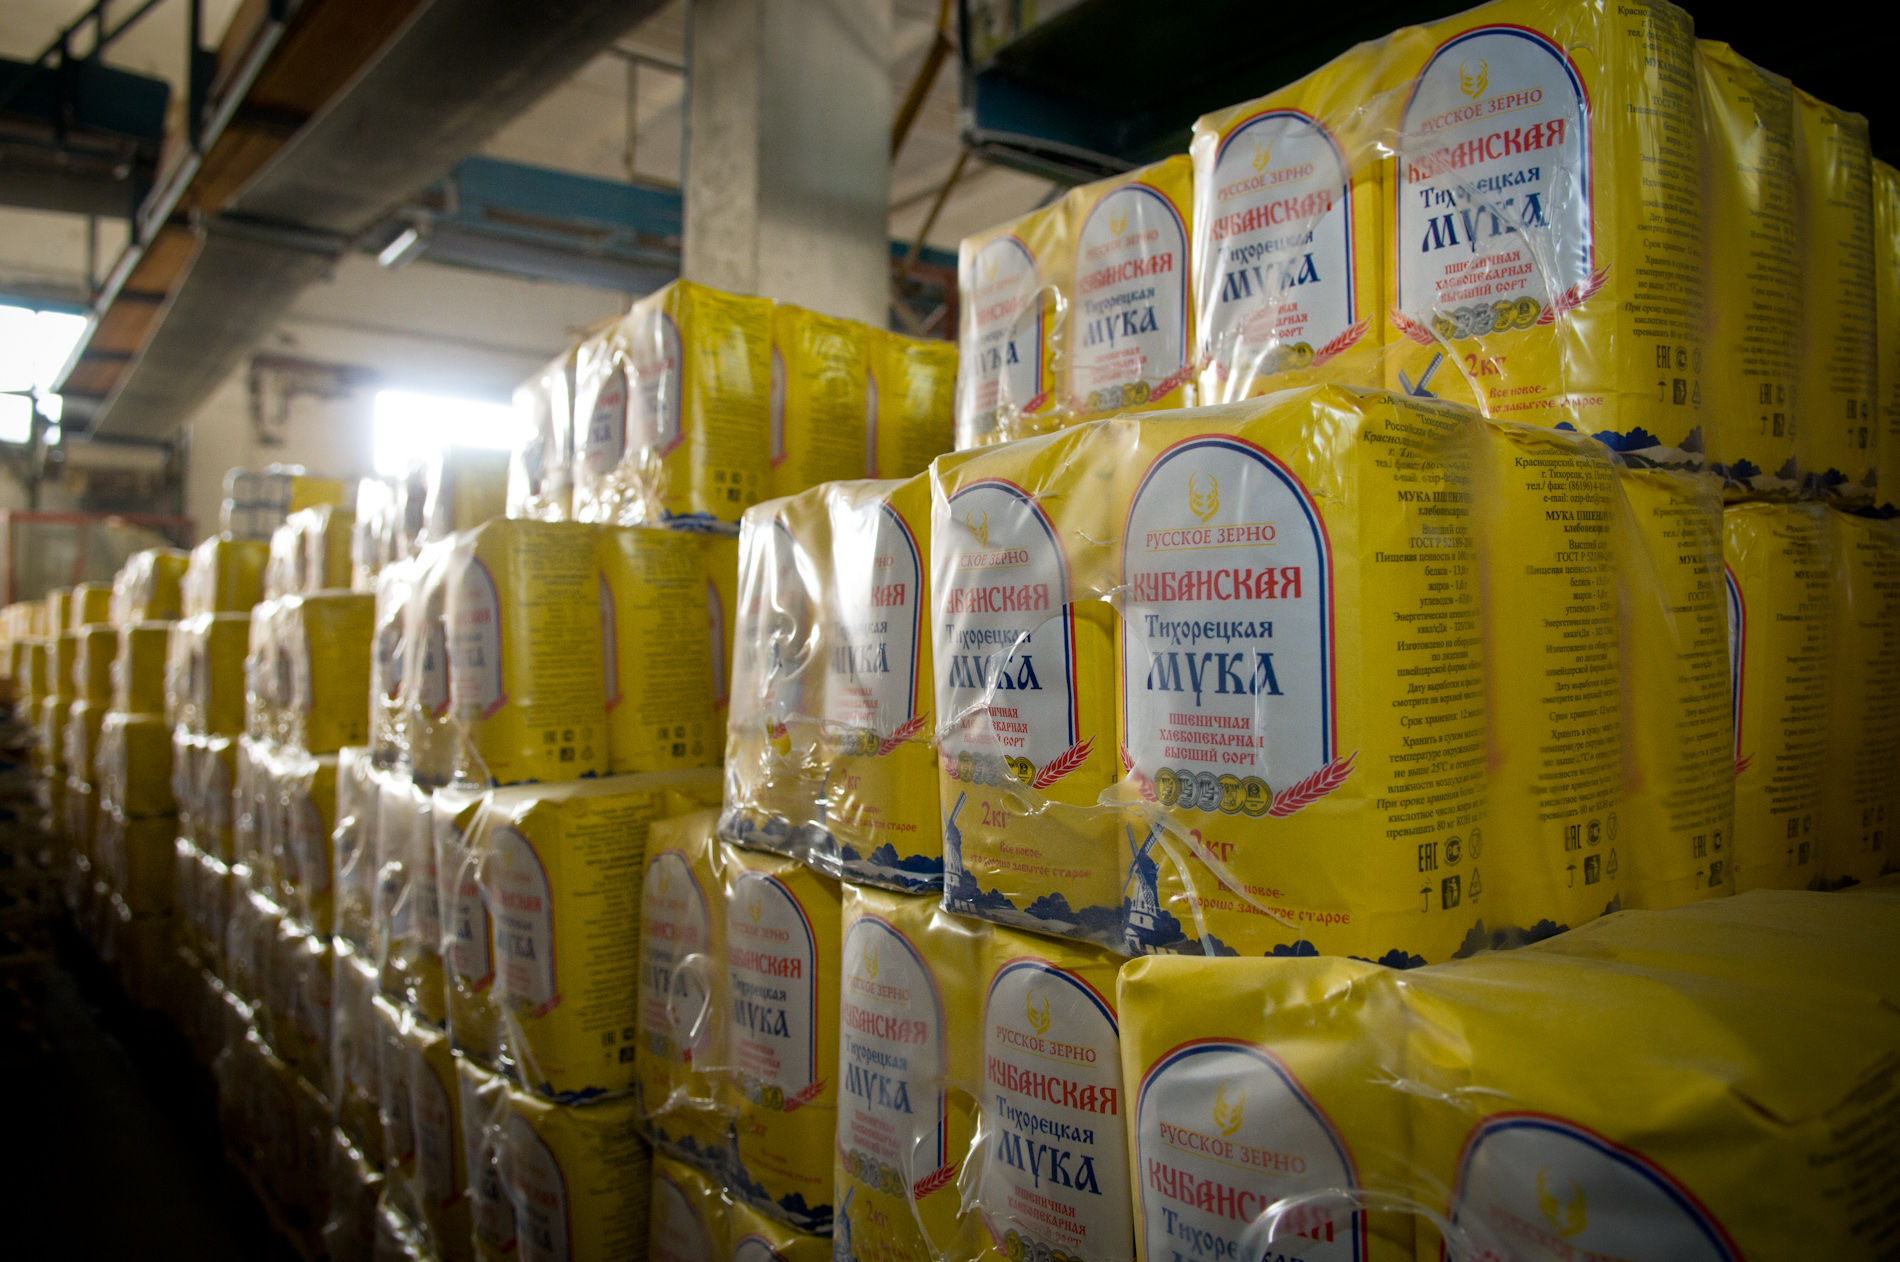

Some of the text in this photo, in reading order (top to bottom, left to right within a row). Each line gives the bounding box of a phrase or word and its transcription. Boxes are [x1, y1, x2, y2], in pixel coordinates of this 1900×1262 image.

[1421, 88, 1543, 132] РУССКОЕ ЗЕРНО
[1271, 161, 1314, 185] ЗЕРНО
[1209, 188, 1333, 243] КУБАНСКАЯ
[1422, 192, 1549, 253] МУКА
[1496, 278, 1527, 295] СОРТ
[1515, 457, 1574, 470] Краснодарский
[1398, 491, 1430, 502] МУКА
[1546, 511, 1574, 521] МУКА
[1146, 525, 1276, 549] РУССКОЕ ЗЕРНО
[1410, 537, 1432, 549] ГОСТ
[1375, 552, 1417, 563] Пищевая
[1557, 552, 1579, 562] ГОСТ
[1133, 567, 1302, 602] КУБАНСКАЯ
[944, 584, 1049, 614] УБАНСКАЯ
[1145, 614, 1273, 646] Тихорецкая
[1147, 652, 1284, 707] МУКА
[1392, 698, 1430, 709] смотрите
[1169, 713, 1250, 730] ПШЕНИЧНАЯ
[1400, 715, 1423, 728] Срок
[1003, 735, 1025, 748] СОРТ
[1402, 735, 1437, 749] Хранить
[1164, 746, 1256, 766] ВЫСШИЙ СОРТ
[1388, 749, 1441, 764] температуре
[1393, 769, 1406, 779] не
[1387, 780, 1434, 794] влажности
[1377, 799, 1397, 811] При
[1399, 796, 1425, 810] сроке
[1388, 808, 1434, 823] кислотное
[1386, 824, 1435, 840] превышать
[1299, 911, 1350, 926] старое
[996, 1026, 1097, 1064] РУССКОЕ ЗЕРНО
[845, 1063, 914, 1114] МУКА
[987, 1054, 1119, 1116] КУБАНСКАЯ
[996, 1094, 1095, 1145] Тихорецкая
[1160, 1122, 1307, 1175] РУССКОЕ ЗЕРНО
[997, 1128, 1102, 1196] МУКА
